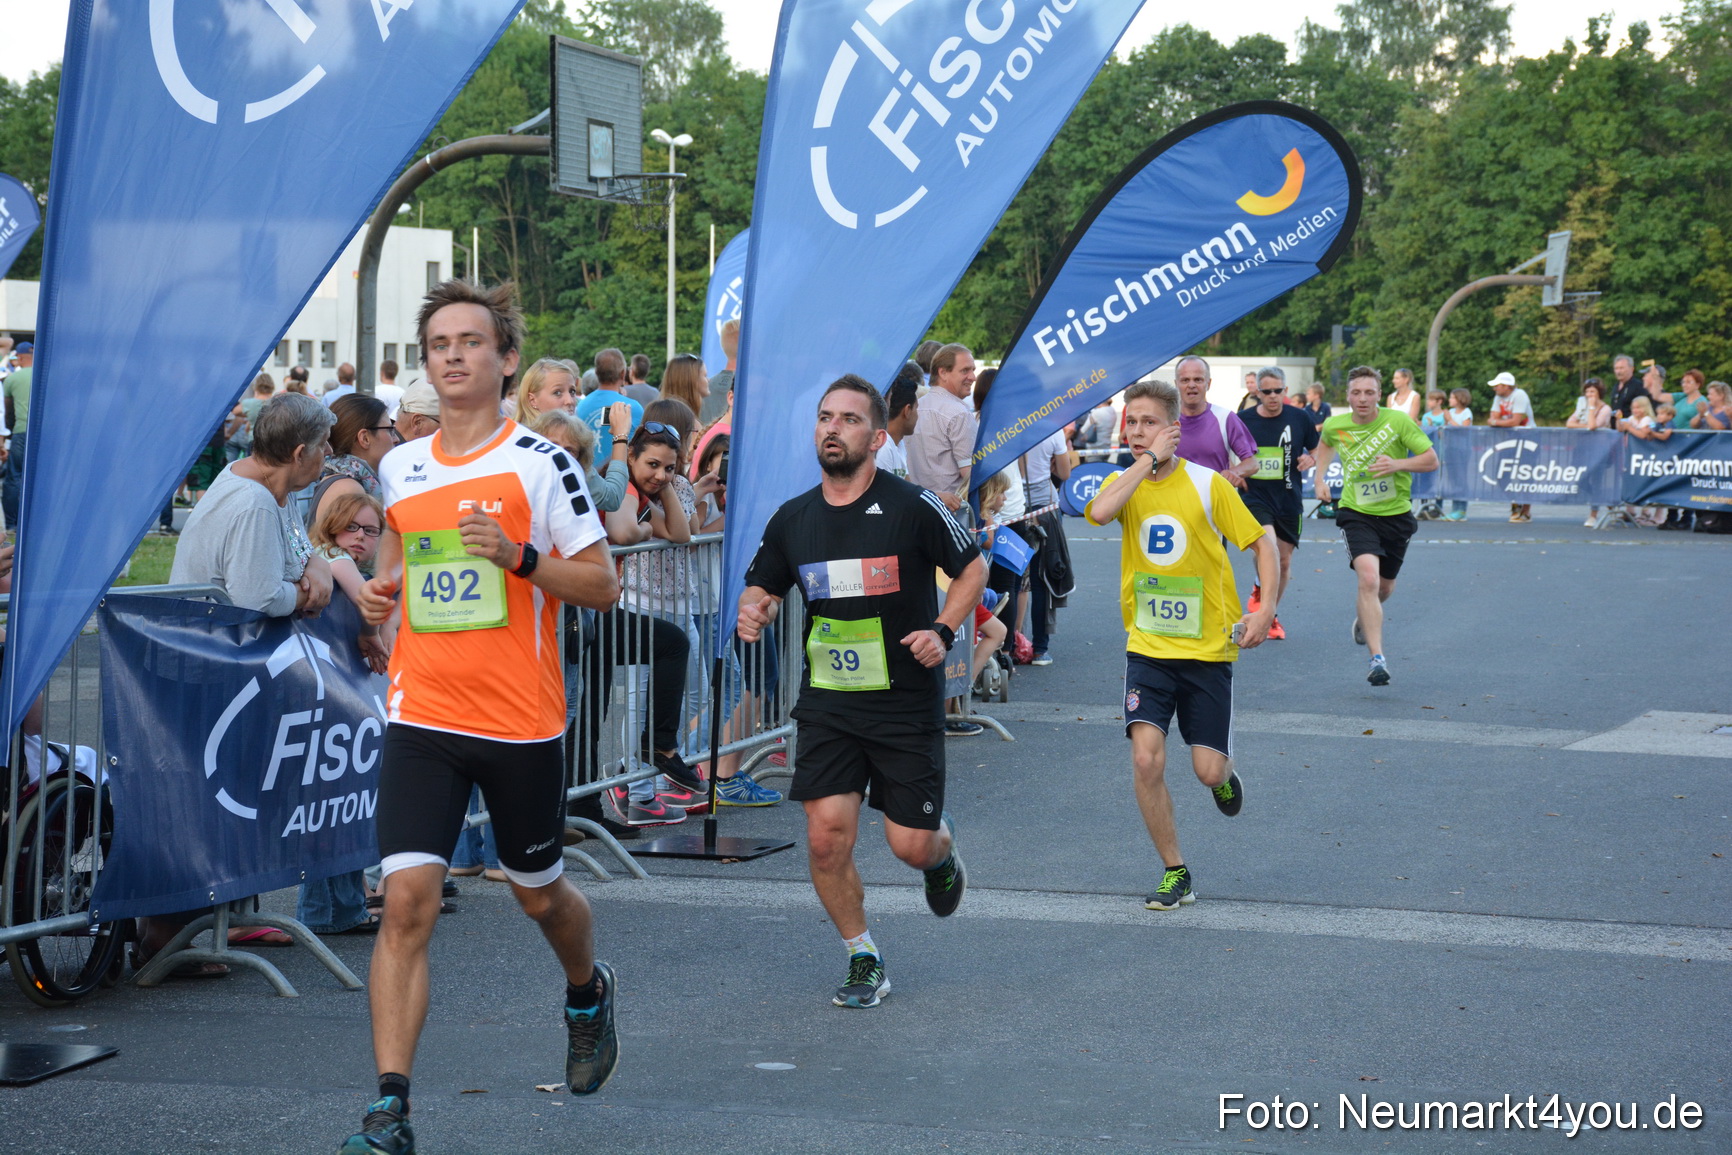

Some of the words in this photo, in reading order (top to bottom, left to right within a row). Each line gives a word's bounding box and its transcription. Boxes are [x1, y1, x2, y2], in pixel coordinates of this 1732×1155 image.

[1176, 267, 1231, 307] Druck
[1232, 247, 1269, 275] und
[1269, 203, 1338, 257] Medien
[1032, 221, 1257, 367] Frischmann
[1258, 459, 1280, 471] 150
[1497, 459, 1587, 482] Fischer
[1630, 453, 1732, 477] Frischmann
[404, 475, 427, 483] erima
[1361, 481, 1389, 497] 216
[1504, 482, 1578, 494] AUTOMOBILE
[1691, 476, 1718, 489] Druck
[1147, 524, 1175, 555] B
[421, 569, 481, 603] 492
[1147, 598, 1188, 621] 159
[828, 648, 860, 672] 39
